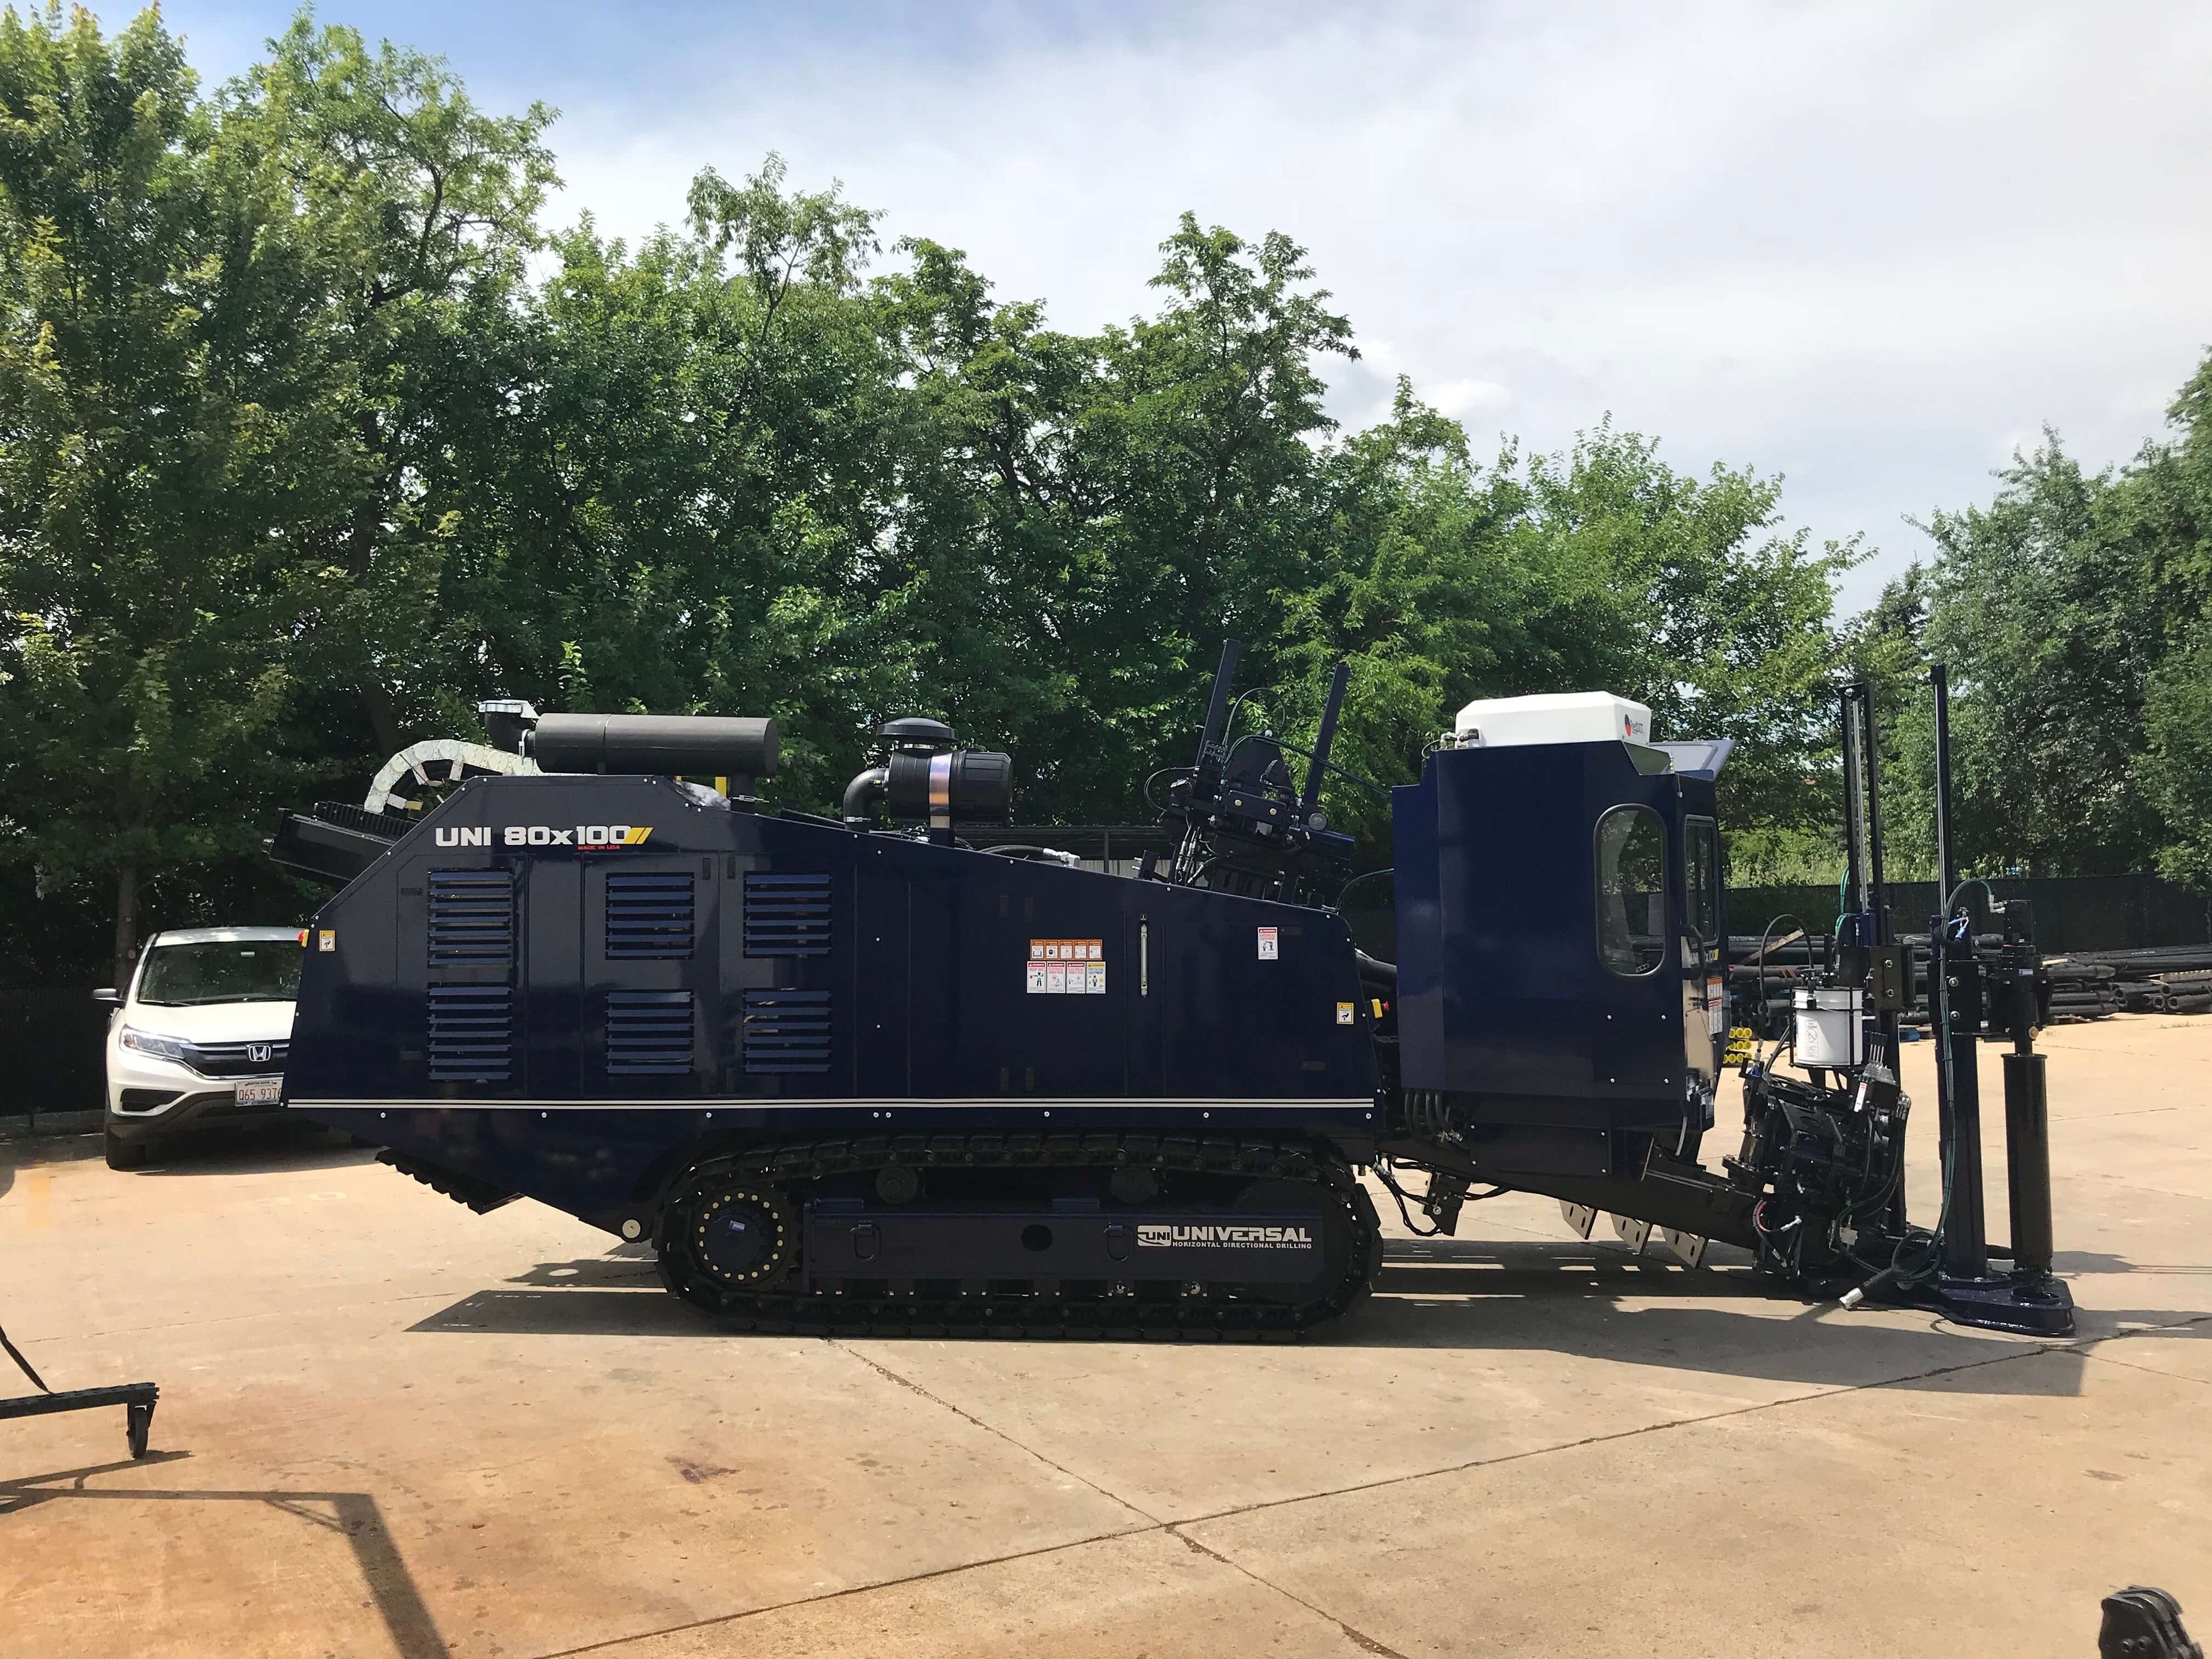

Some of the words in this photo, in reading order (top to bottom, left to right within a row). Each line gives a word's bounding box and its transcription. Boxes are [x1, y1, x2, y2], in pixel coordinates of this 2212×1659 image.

[435, 827, 491, 846] UNI
[504, 825, 634, 846] 80x100
[1172, 1226, 1312, 1242] UNIVERSAL
